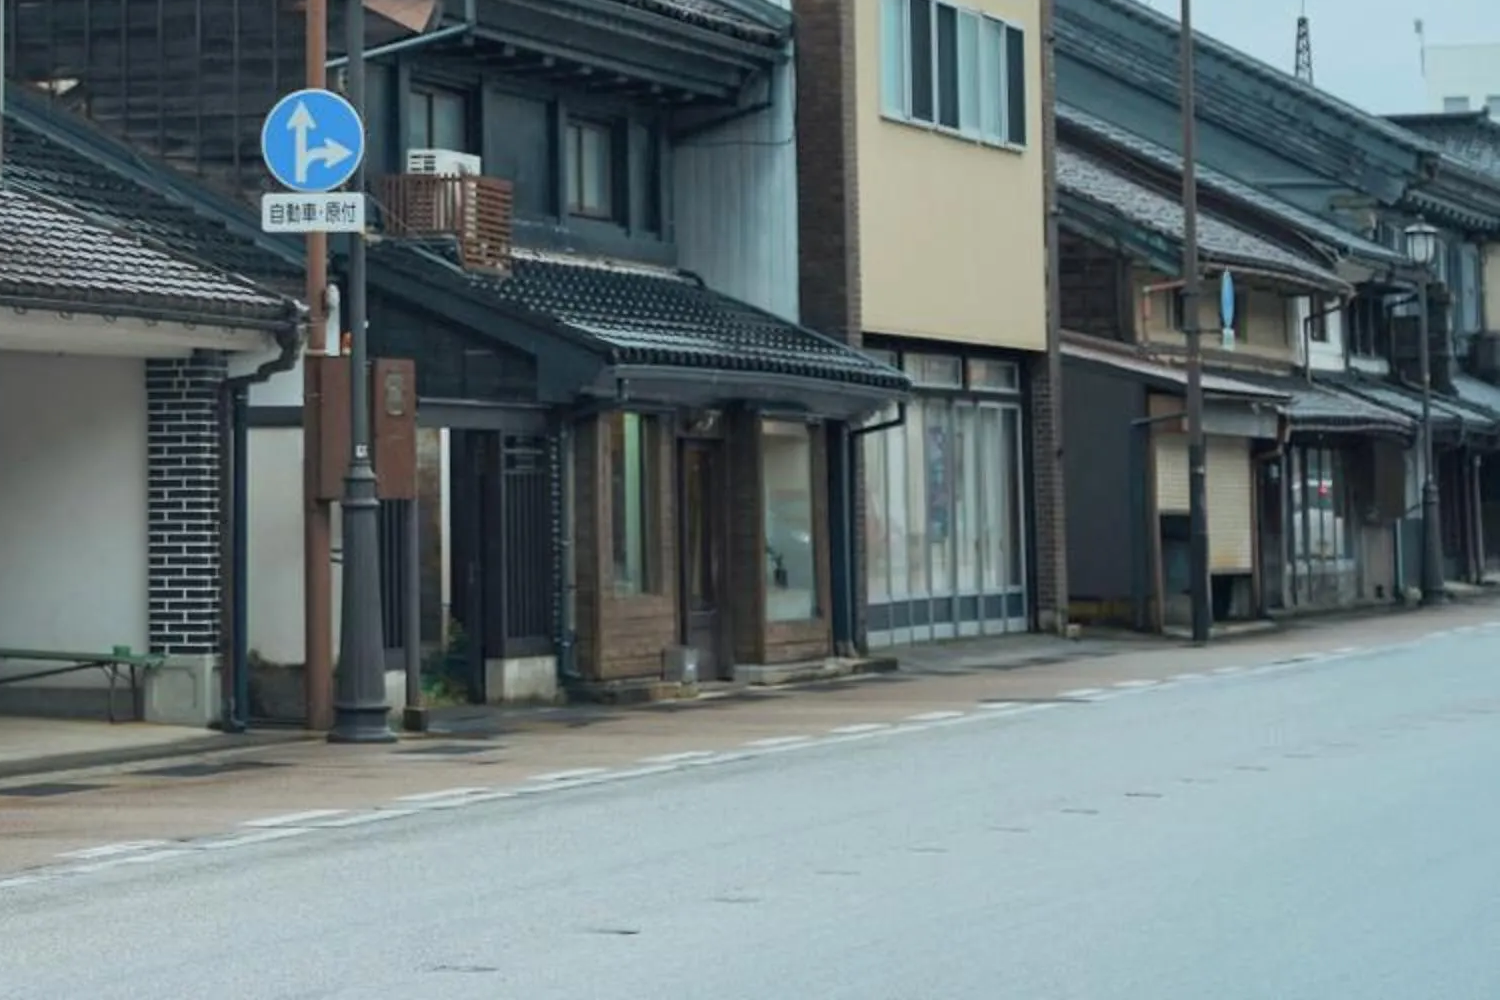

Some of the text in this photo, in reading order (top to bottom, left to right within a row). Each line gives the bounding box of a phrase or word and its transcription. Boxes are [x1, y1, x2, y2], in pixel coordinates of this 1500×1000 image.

[269, 202, 356, 225] 自動車・原付
